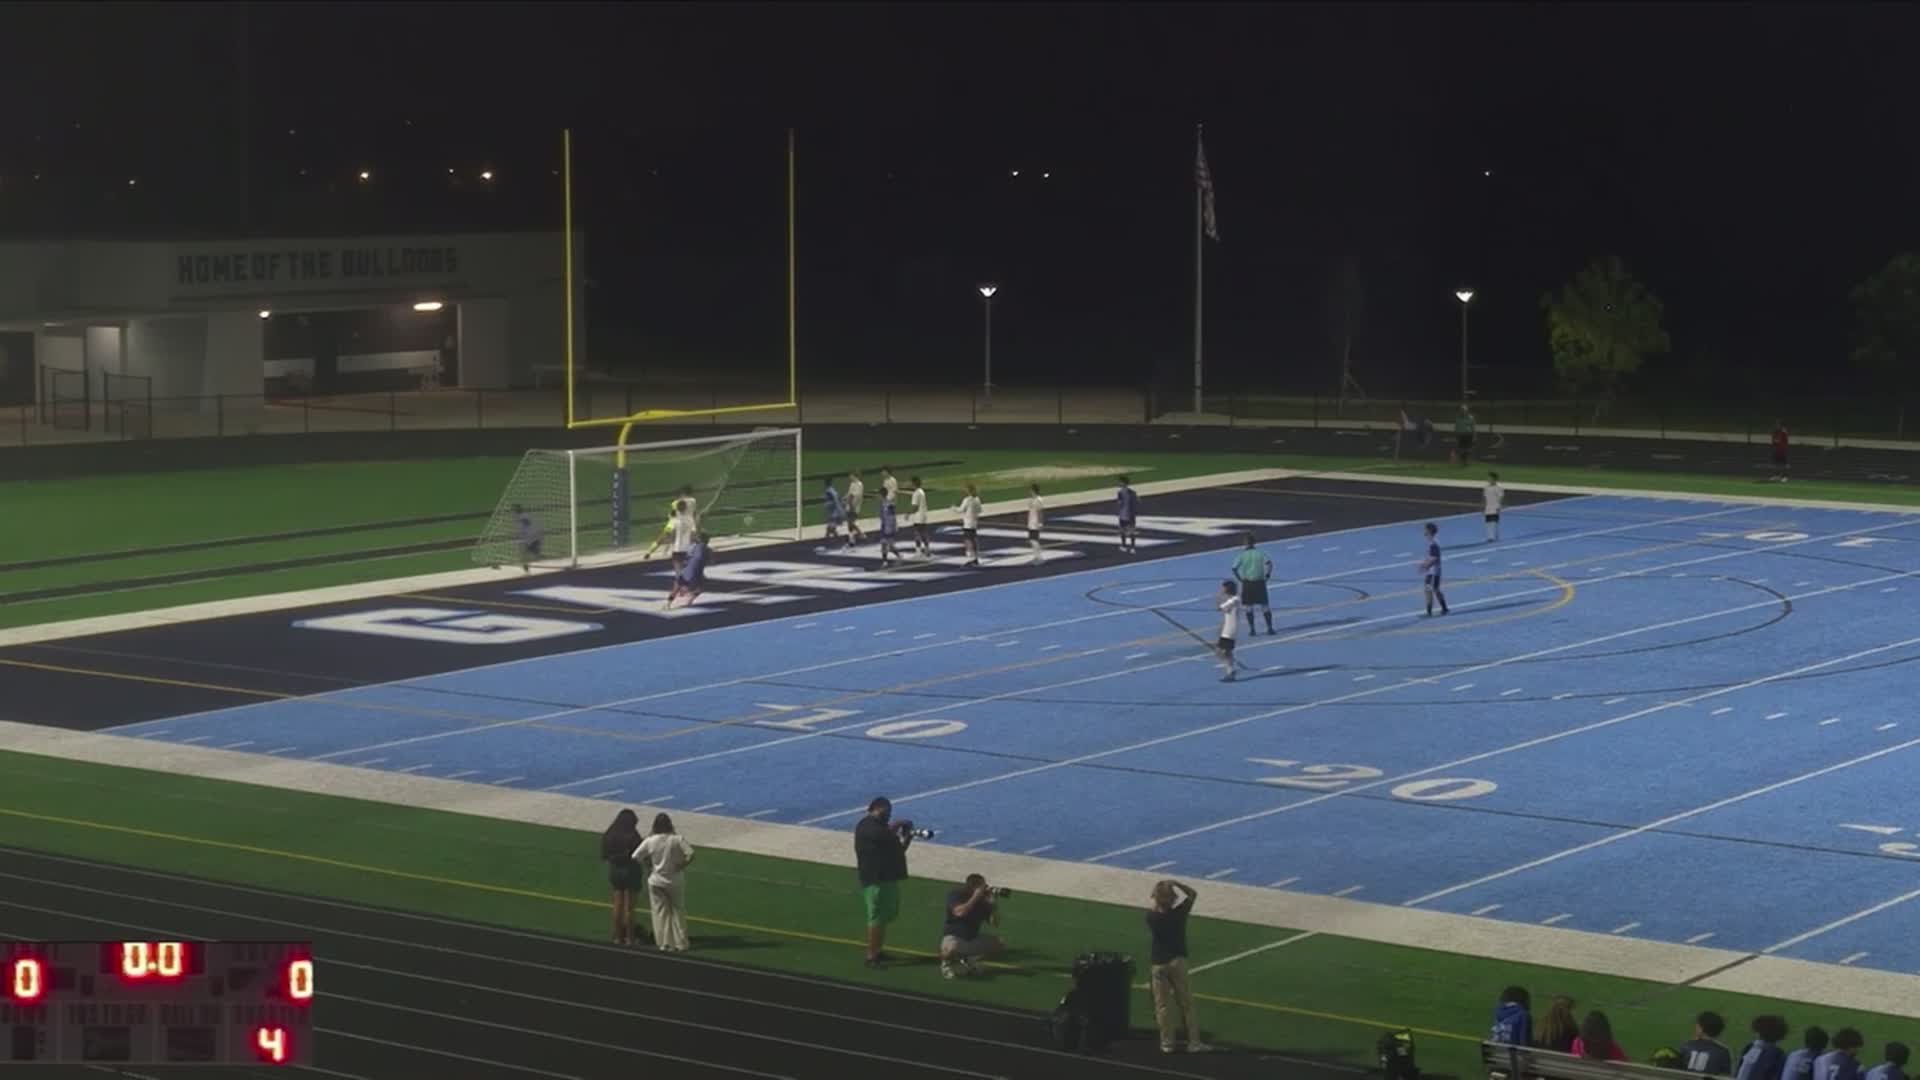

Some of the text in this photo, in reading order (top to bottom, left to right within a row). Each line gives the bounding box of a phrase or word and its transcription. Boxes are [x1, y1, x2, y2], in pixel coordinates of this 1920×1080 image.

[177, 254, 248, 285] HOME
[249, 252, 281, 281] OF
[288, 249, 332, 281] THE
